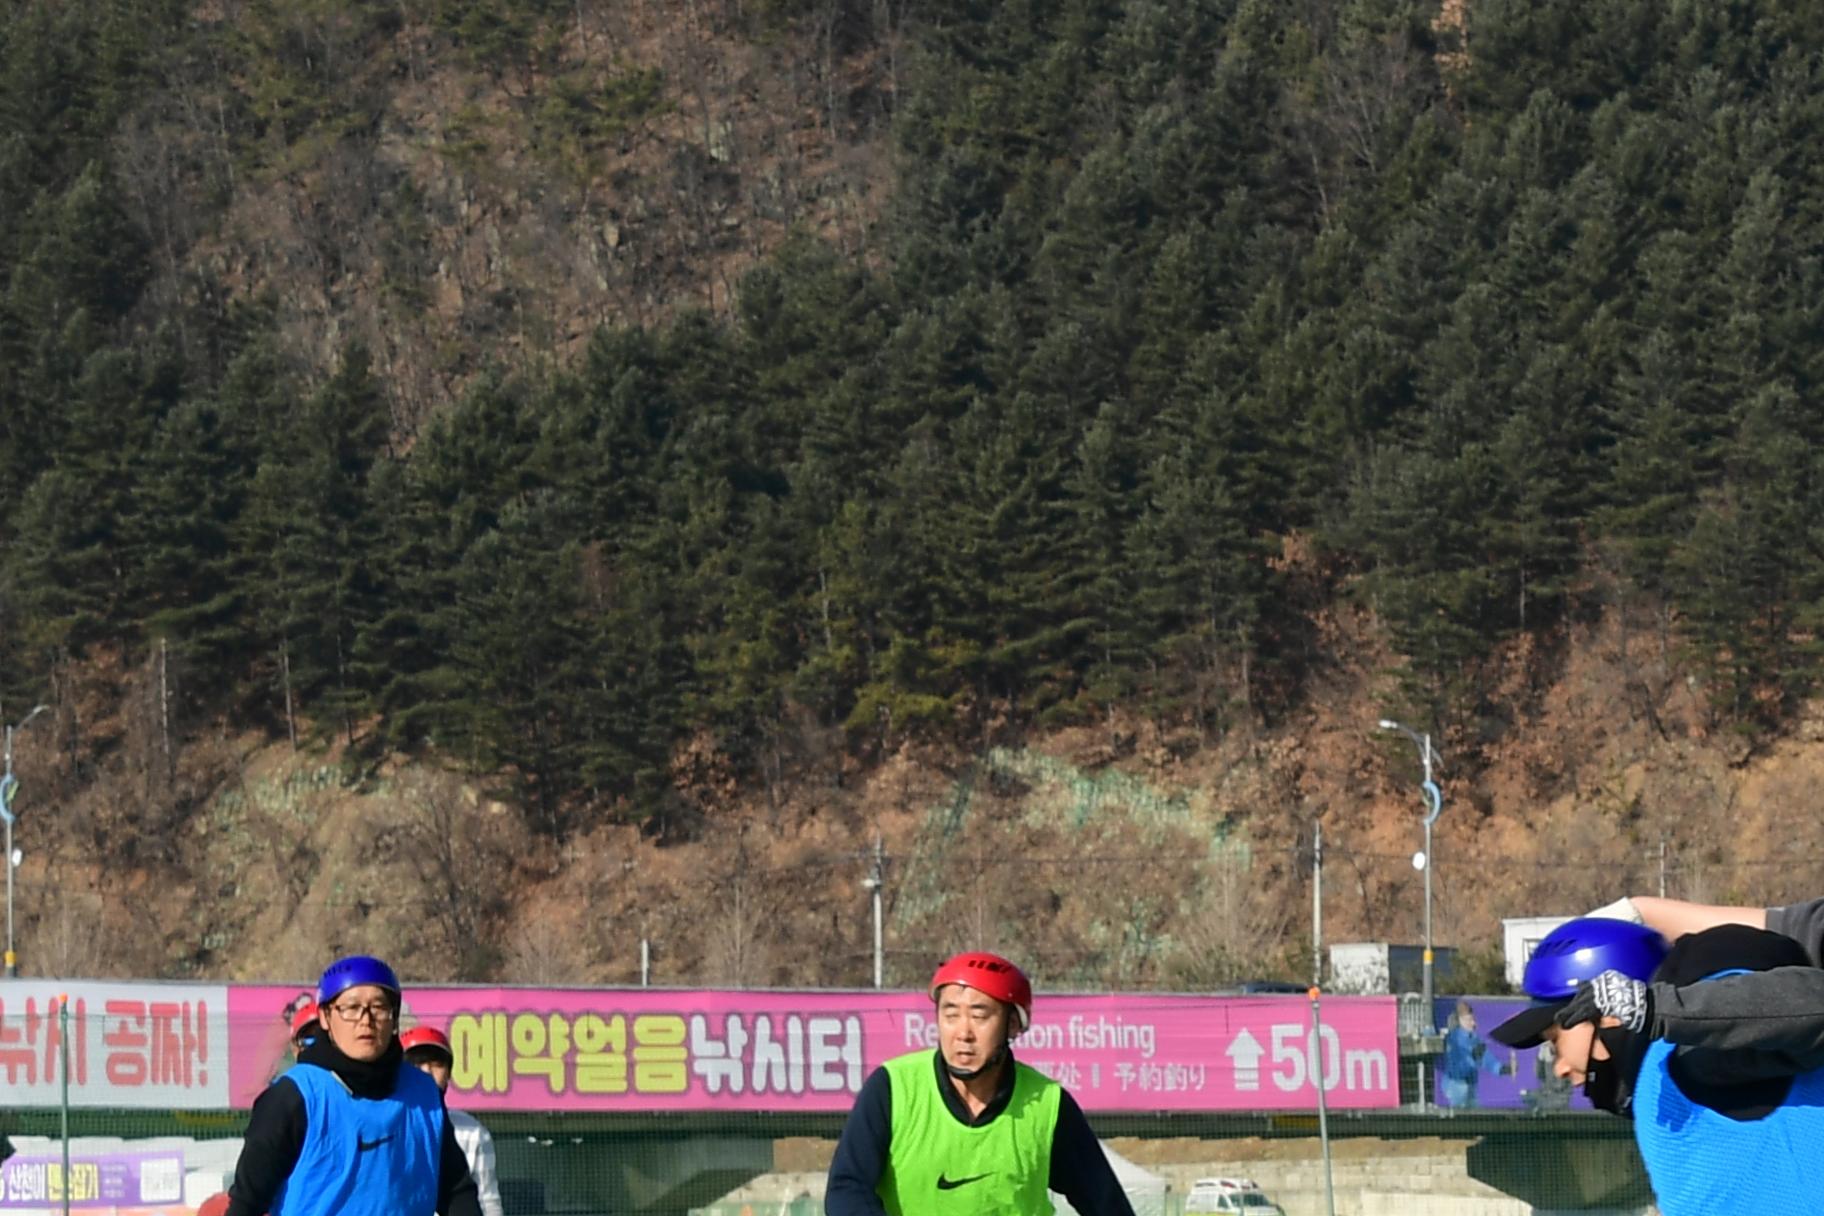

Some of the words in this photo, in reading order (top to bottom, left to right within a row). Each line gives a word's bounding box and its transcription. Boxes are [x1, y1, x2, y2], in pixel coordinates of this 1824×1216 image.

[105, 999, 209, 1088] 공짜!
[1069, 1014, 1156, 1058] fishing
[1270, 1023, 1389, 1092] 50m
